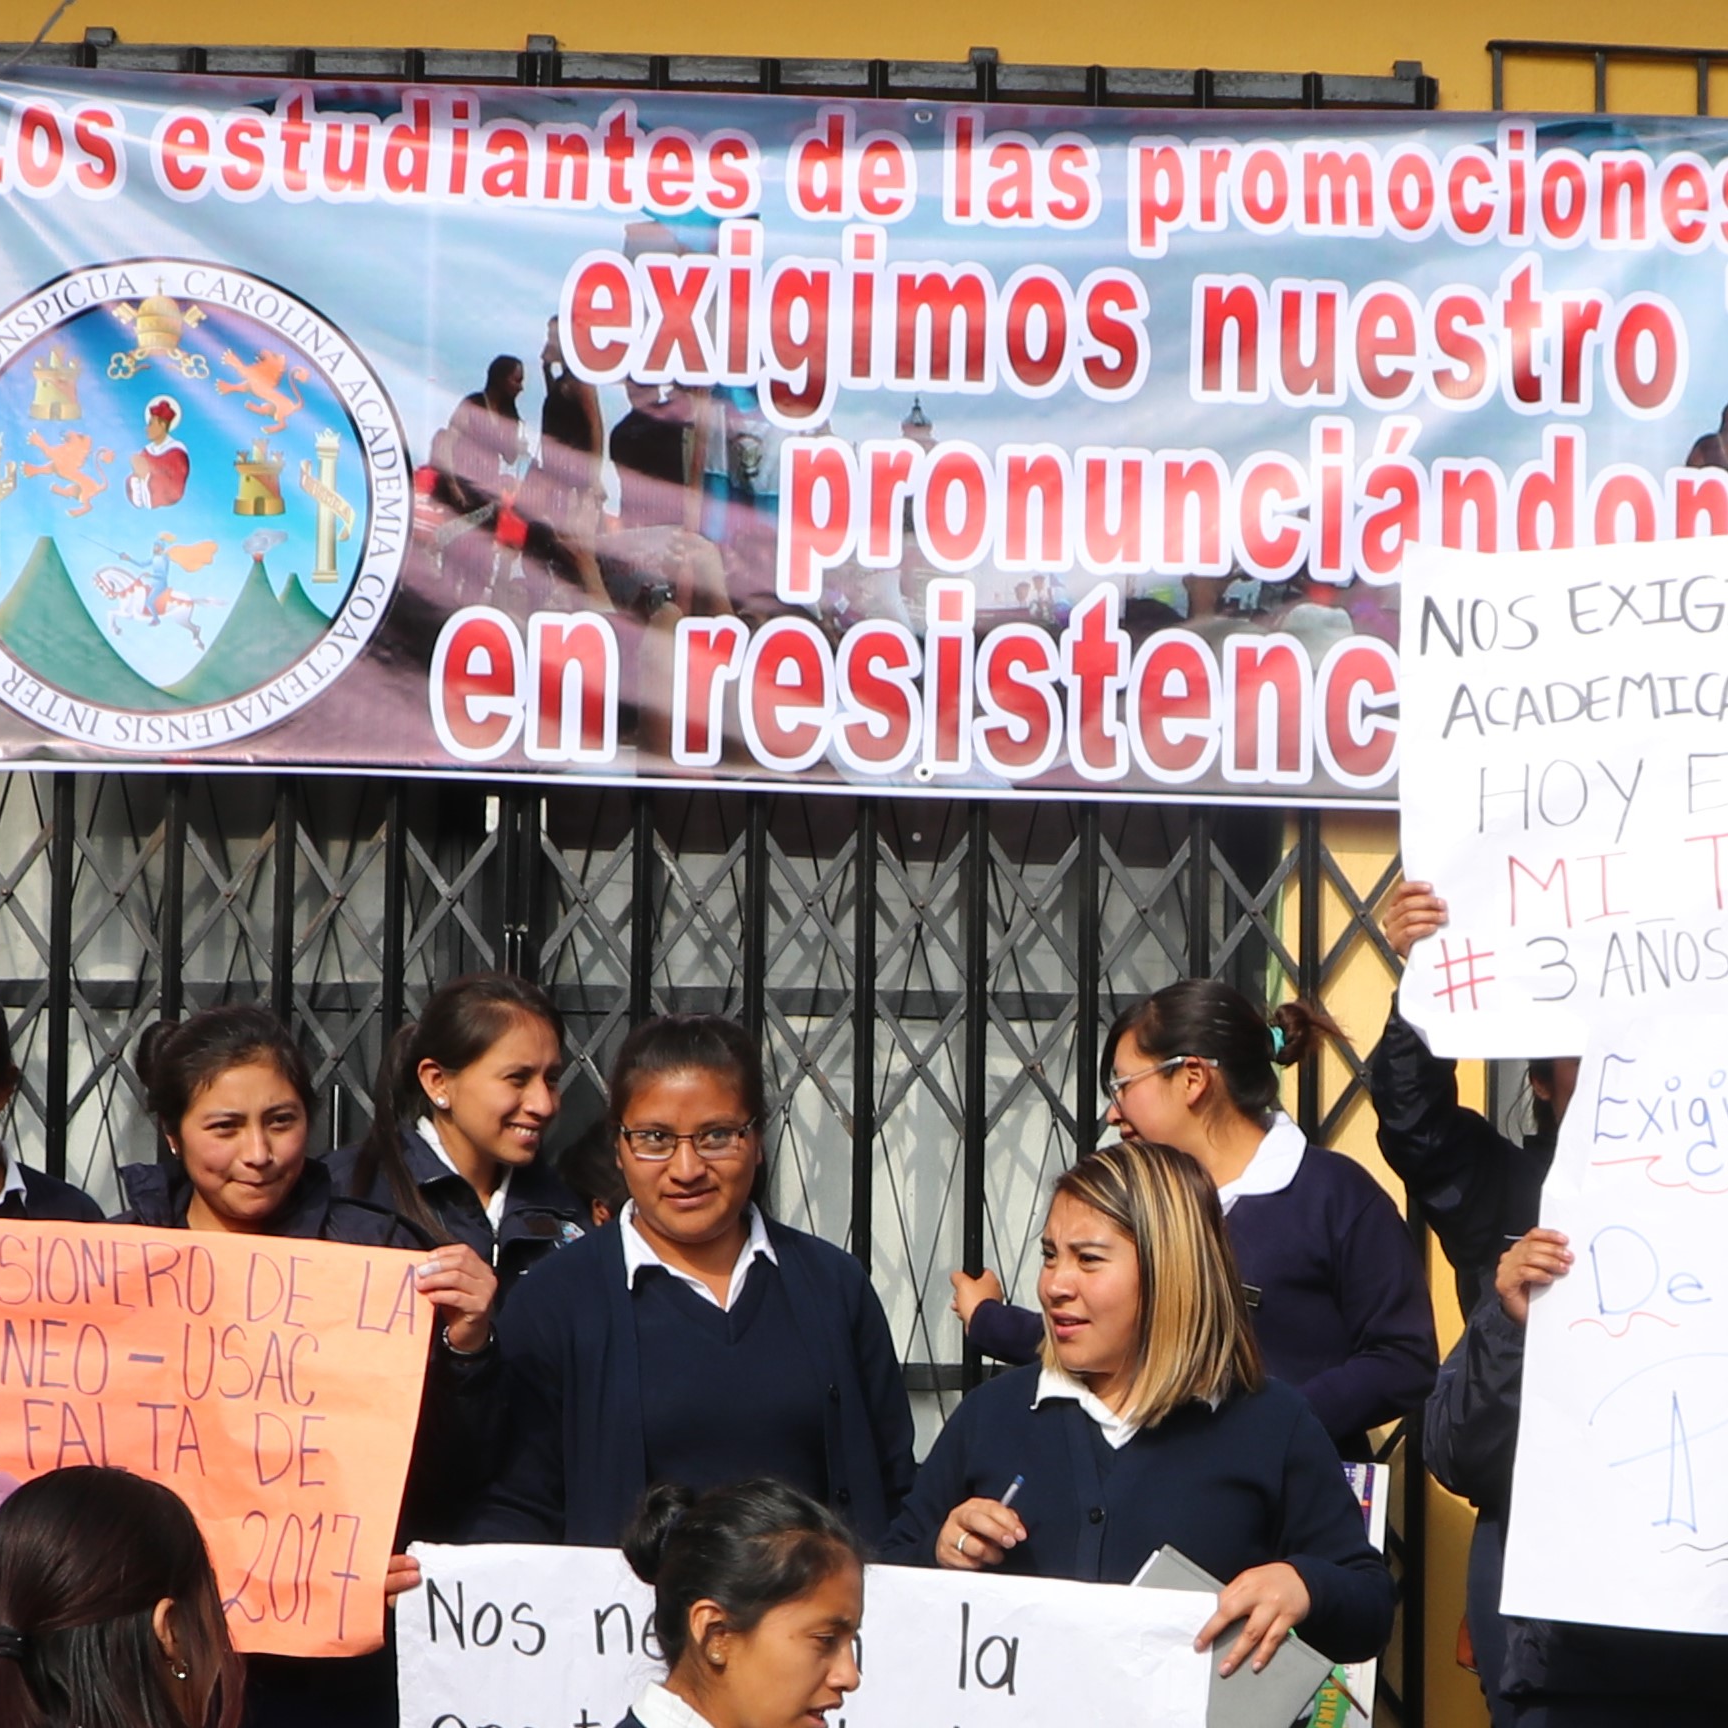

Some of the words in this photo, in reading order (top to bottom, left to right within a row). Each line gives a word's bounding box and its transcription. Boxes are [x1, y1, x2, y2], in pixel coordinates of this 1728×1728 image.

[161, 92, 750, 210] estudiantes
[797, 114, 907, 216] de
[954, 116, 1092, 221] las
[183, 270, 348, 376] CAROLINA
[569, 228, 1140, 419] exigimos
[1201, 263, 1680, 409] nuestro
[341, 376, 404, 562] ACADEMIA
[1419, 595, 1539, 658] NOS
[2, 664, 99, 737] INTER
[441, 616, 607, 754] en
[1478, 758, 1644, 843] HOY
[1507, 852, 1630, 928] MI
[247, 1253, 313, 1328] DE
[356, 1259, 418, 1336] LA
[1589, 1225, 1713, 1316] De
[253, 1411, 326, 1488] DE
[222, 1510, 361, 1641] 2017
[425, 1577, 547, 1660] Nos
[959, 1602, 1020, 1696] la
